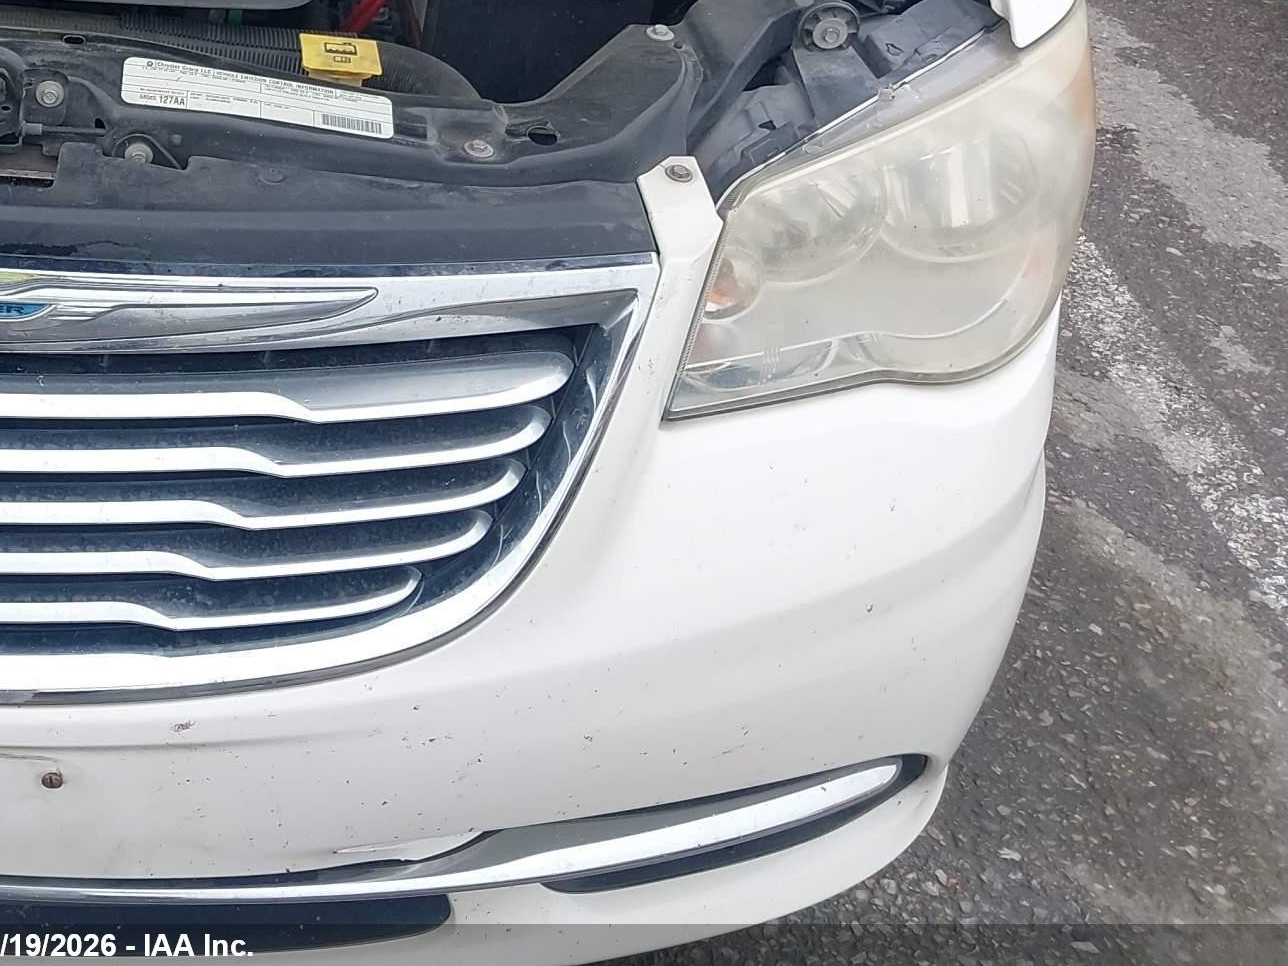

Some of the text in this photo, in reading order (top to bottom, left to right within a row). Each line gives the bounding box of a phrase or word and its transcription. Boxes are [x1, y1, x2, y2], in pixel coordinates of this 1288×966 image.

[157, 61, 180, 70] Chrysler
[269, 79, 293, 87] CONTROL
[160, 95, 185, 106] 127AA
